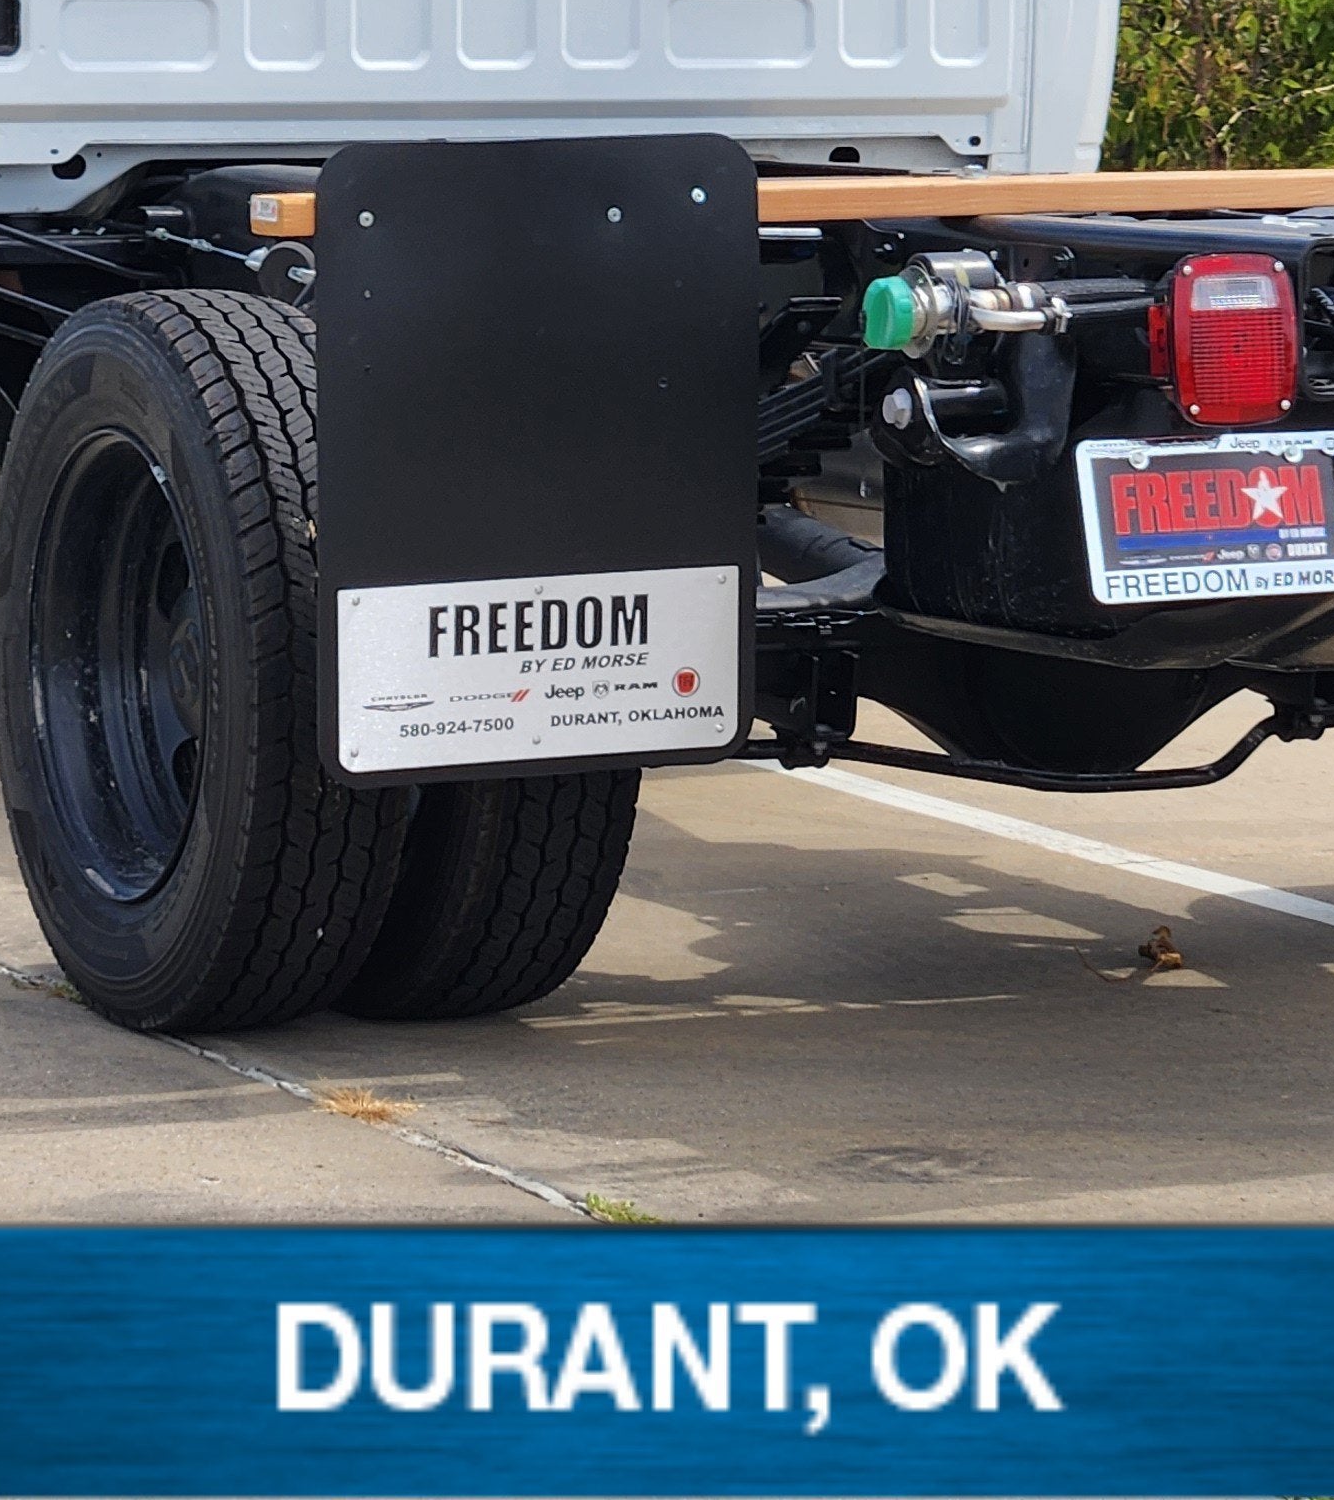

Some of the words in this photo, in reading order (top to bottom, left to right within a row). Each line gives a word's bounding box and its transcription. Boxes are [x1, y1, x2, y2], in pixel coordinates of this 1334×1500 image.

[1109, 465, 1326, 535] FREEDOM
[1105, 568, 1249, 598] FREEDOM
[1274, 572, 1294, 587] ED
[428, 594, 649, 658] FREEDOM
[520, 659, 547, 674] BY
[551, 657, 576, 672] ED
[581, 652, 650, 670] MORSE
[545, 684, 586, 701] Jeep
[614, 682, 659, 691] RAM
[399, 717, 515, 738] 580-924-7500
[551, 711, 623, 727] DURANT,
[628, 706, 725, 722] OKLAHOMA
